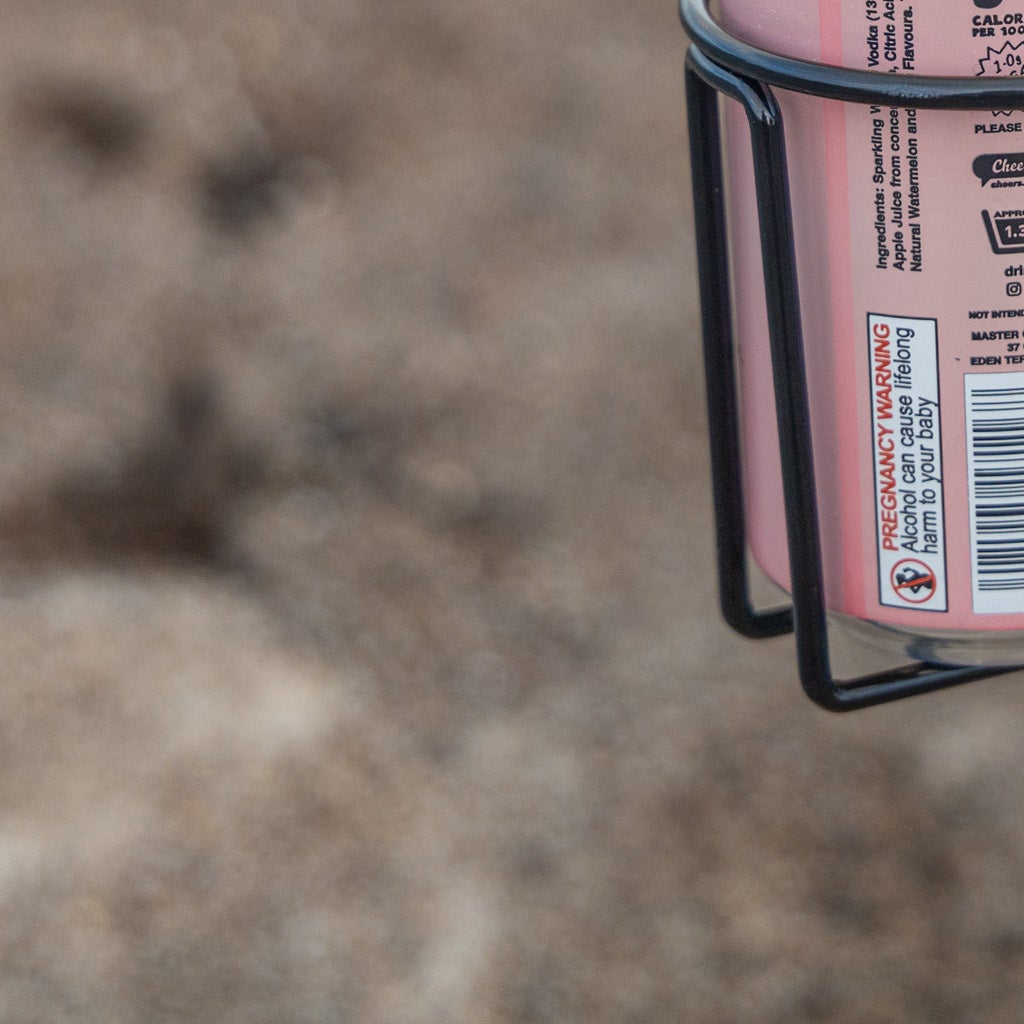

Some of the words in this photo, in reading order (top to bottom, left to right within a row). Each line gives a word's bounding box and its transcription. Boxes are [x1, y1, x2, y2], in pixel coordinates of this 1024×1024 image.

[867, 25, 880, 67] Vodka
[883, 24, 897, 62] Citric
[902, 6, 915, 70] Flavours.
[972, 26, 995, 38] PER
[904, 108, 917, 134] and
[974, 123, 1022, 134] PLEASE
[871, 119, 886, 184] Sparkling
[890, 156, 901, 187] from
[906, 138, 921, 219] Watermelon
[874, 188, 889, 269] Ingredients:
[890, 191, 903, 228] Juice
[892, 233, 906, 271] Apple
[909, 224, 922, 272] Natural
[968, 311, 990, 319] NOT
[971, 330, 1019, 341] MASTER
[1007, 342, 1021, 352] 37
[873, 323, 893, 419] WARNING
[893, 327, 915, 389] lifelong
[970, 356, 1001, 366] EDEN
[898, 395, 915, 447] cause
[914, 396, 939, 439] baby
[901, 453, 916, 484] can
[920, 444, 941, 483] your
[878, 423, 899, 551] PREGNANCY
[919, 489, 936, 505] to
[898, 489, 919, 553] Alcohol
[920, 511, 938, 554] harm
